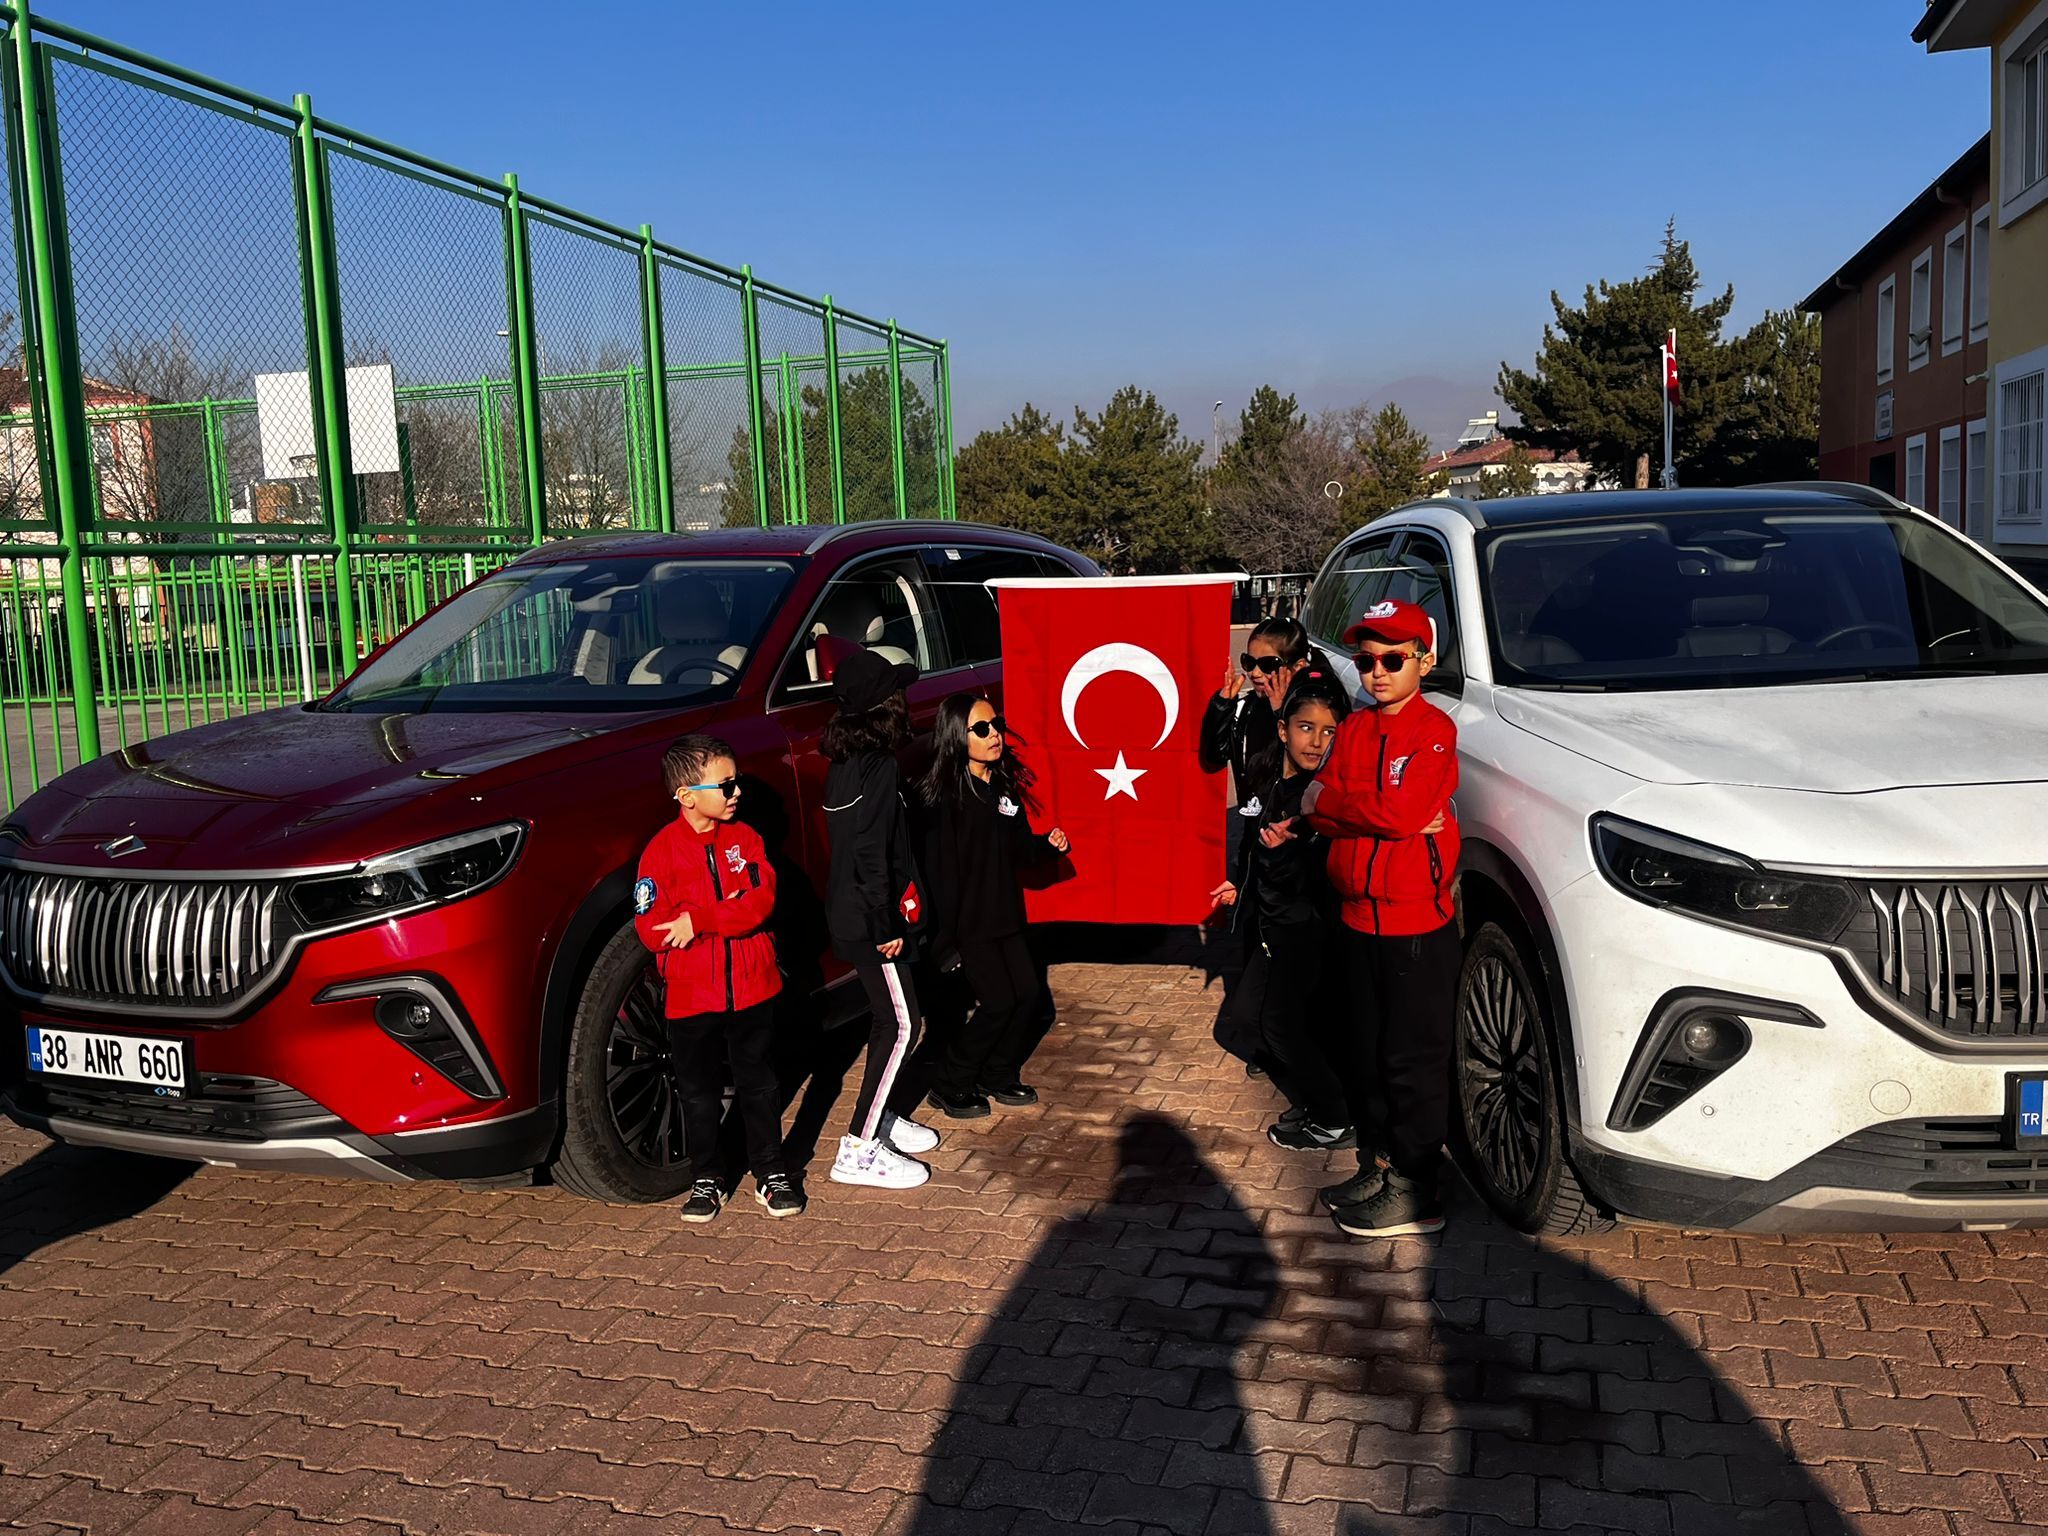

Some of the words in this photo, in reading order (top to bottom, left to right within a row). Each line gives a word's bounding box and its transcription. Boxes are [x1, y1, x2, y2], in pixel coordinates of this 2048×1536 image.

[31, 1052, 42, 1063] TR
[42, 1034, 68, 1069] 38
[84, 1037, 124, 1076] ANR
[138, 1043, 181, 1082] 660
[2021, 1112, 2040, 1126] TR
